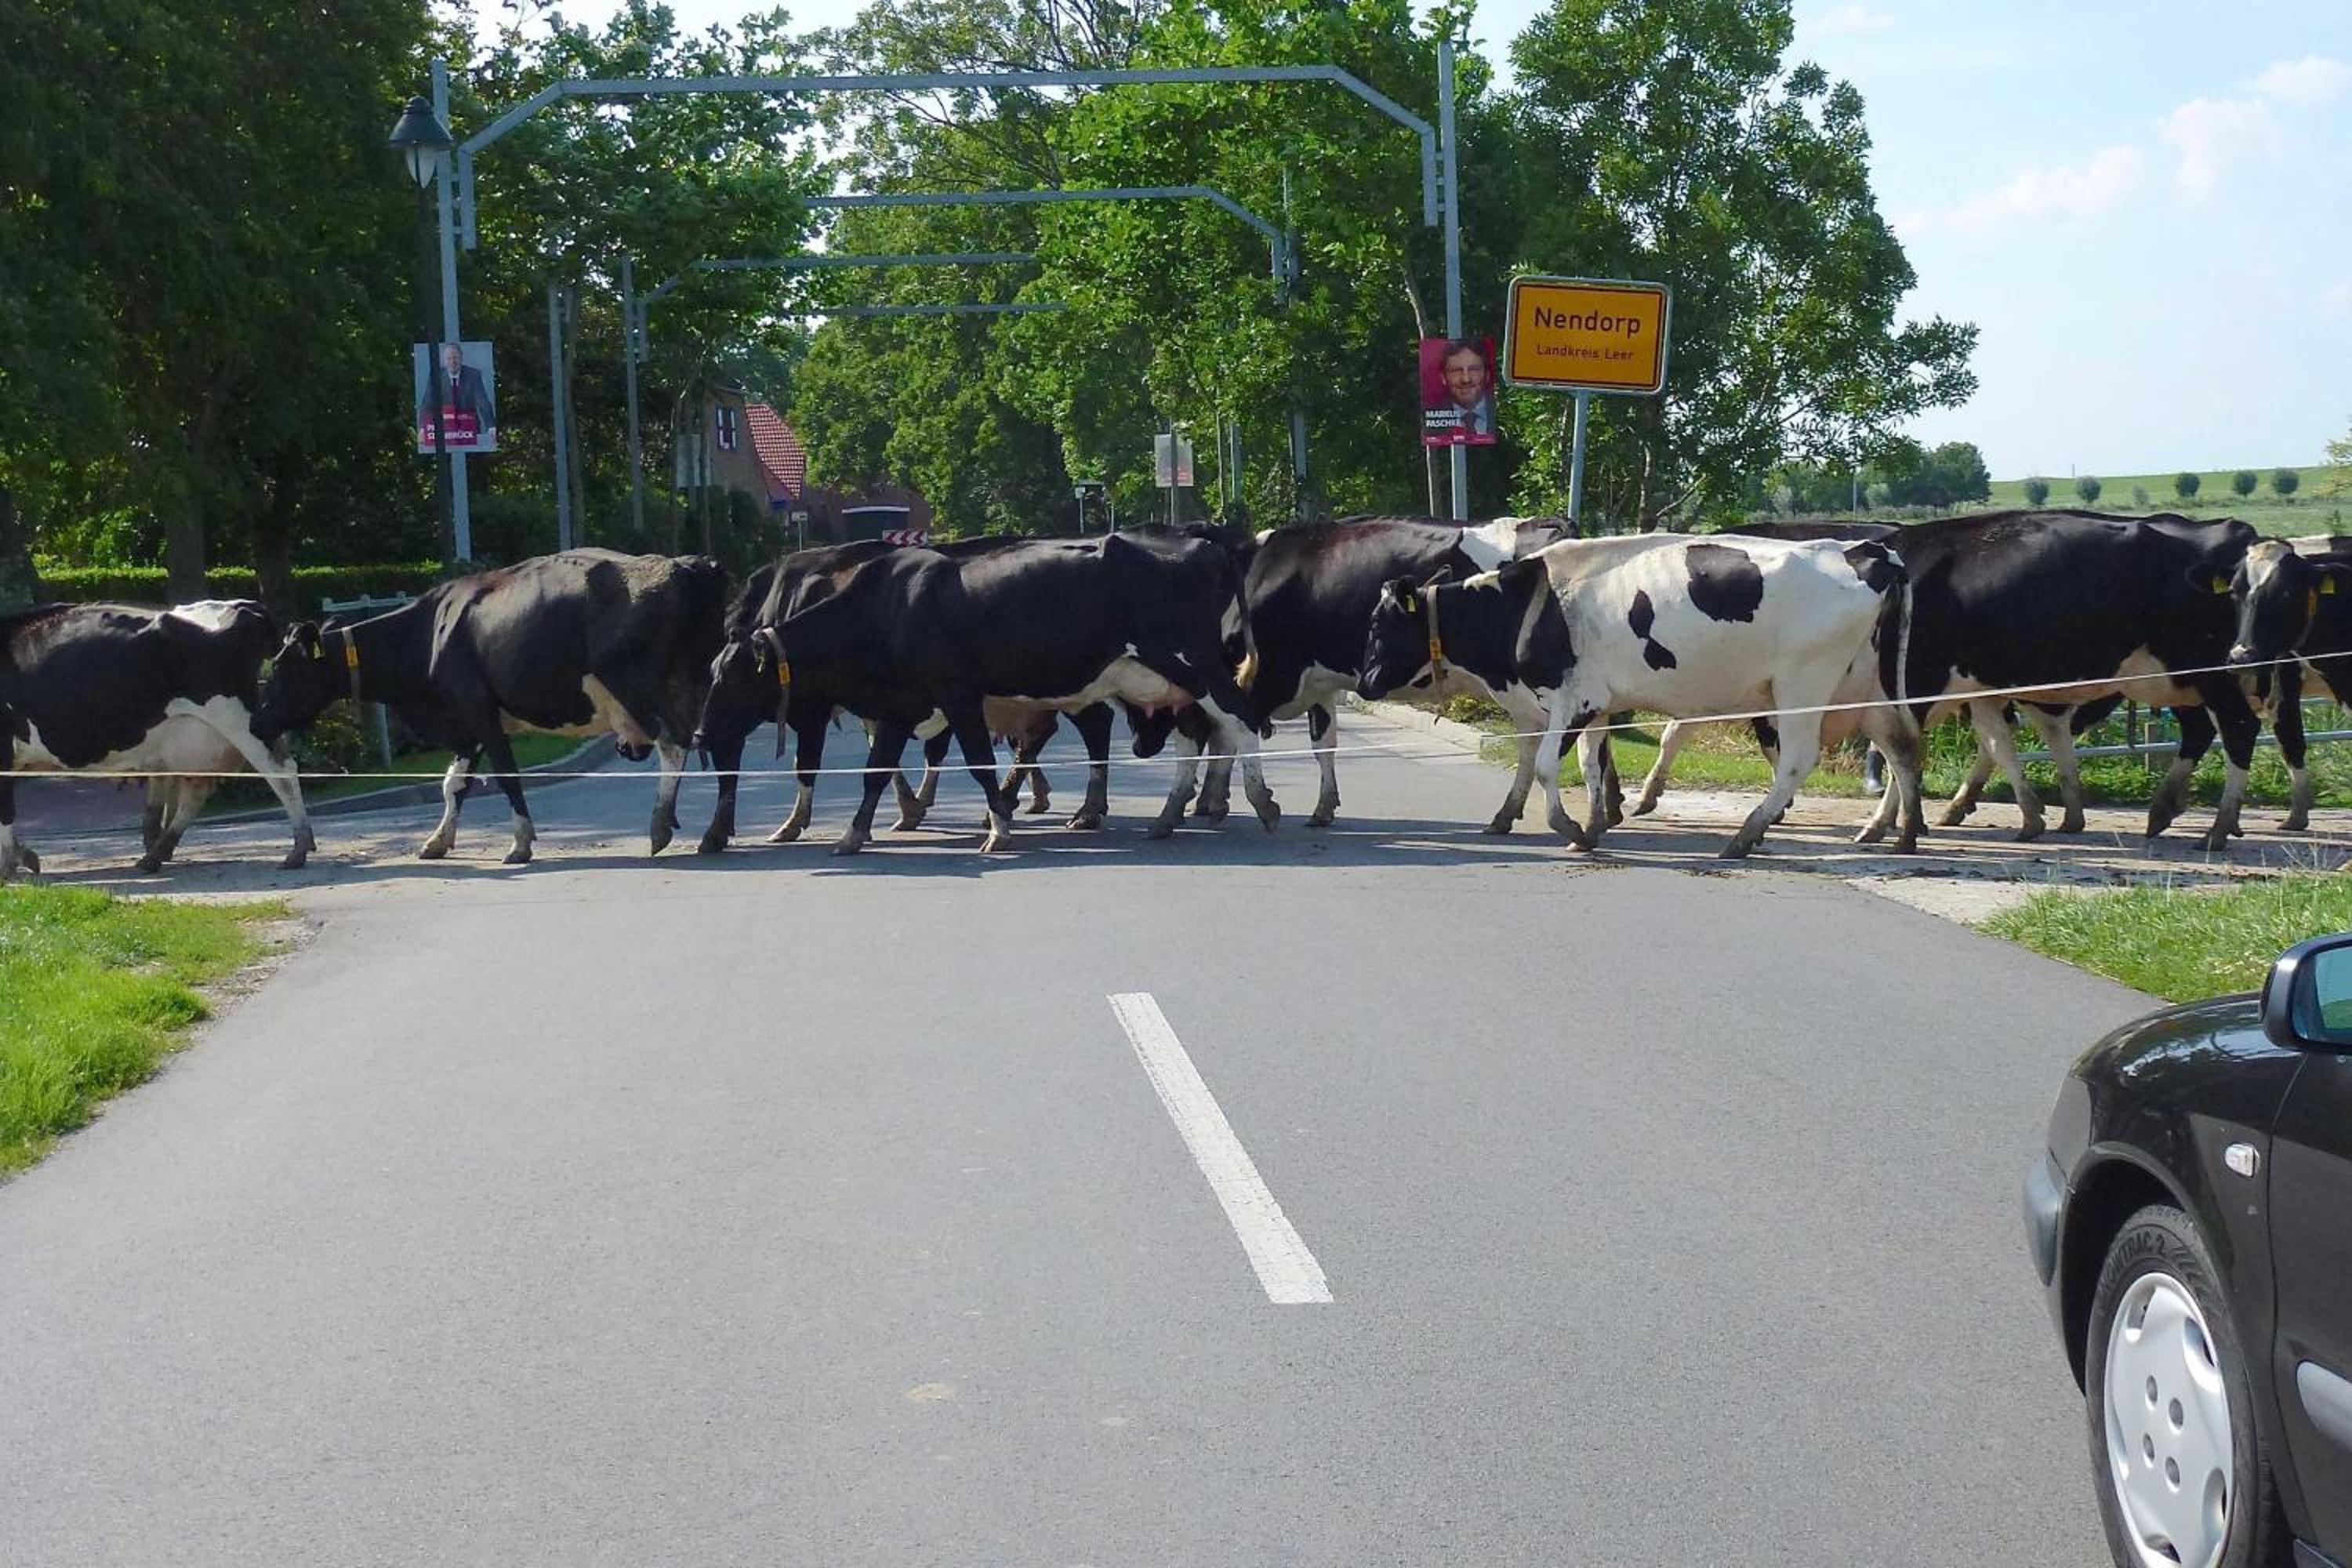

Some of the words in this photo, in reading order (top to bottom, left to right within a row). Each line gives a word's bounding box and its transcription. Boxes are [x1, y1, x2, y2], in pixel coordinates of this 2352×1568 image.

[1534, 307, 1640, 339] Nendorp
[1537, 344, 1599, 358] Landkreis
[1605, 348, 1634, 360] Leer
